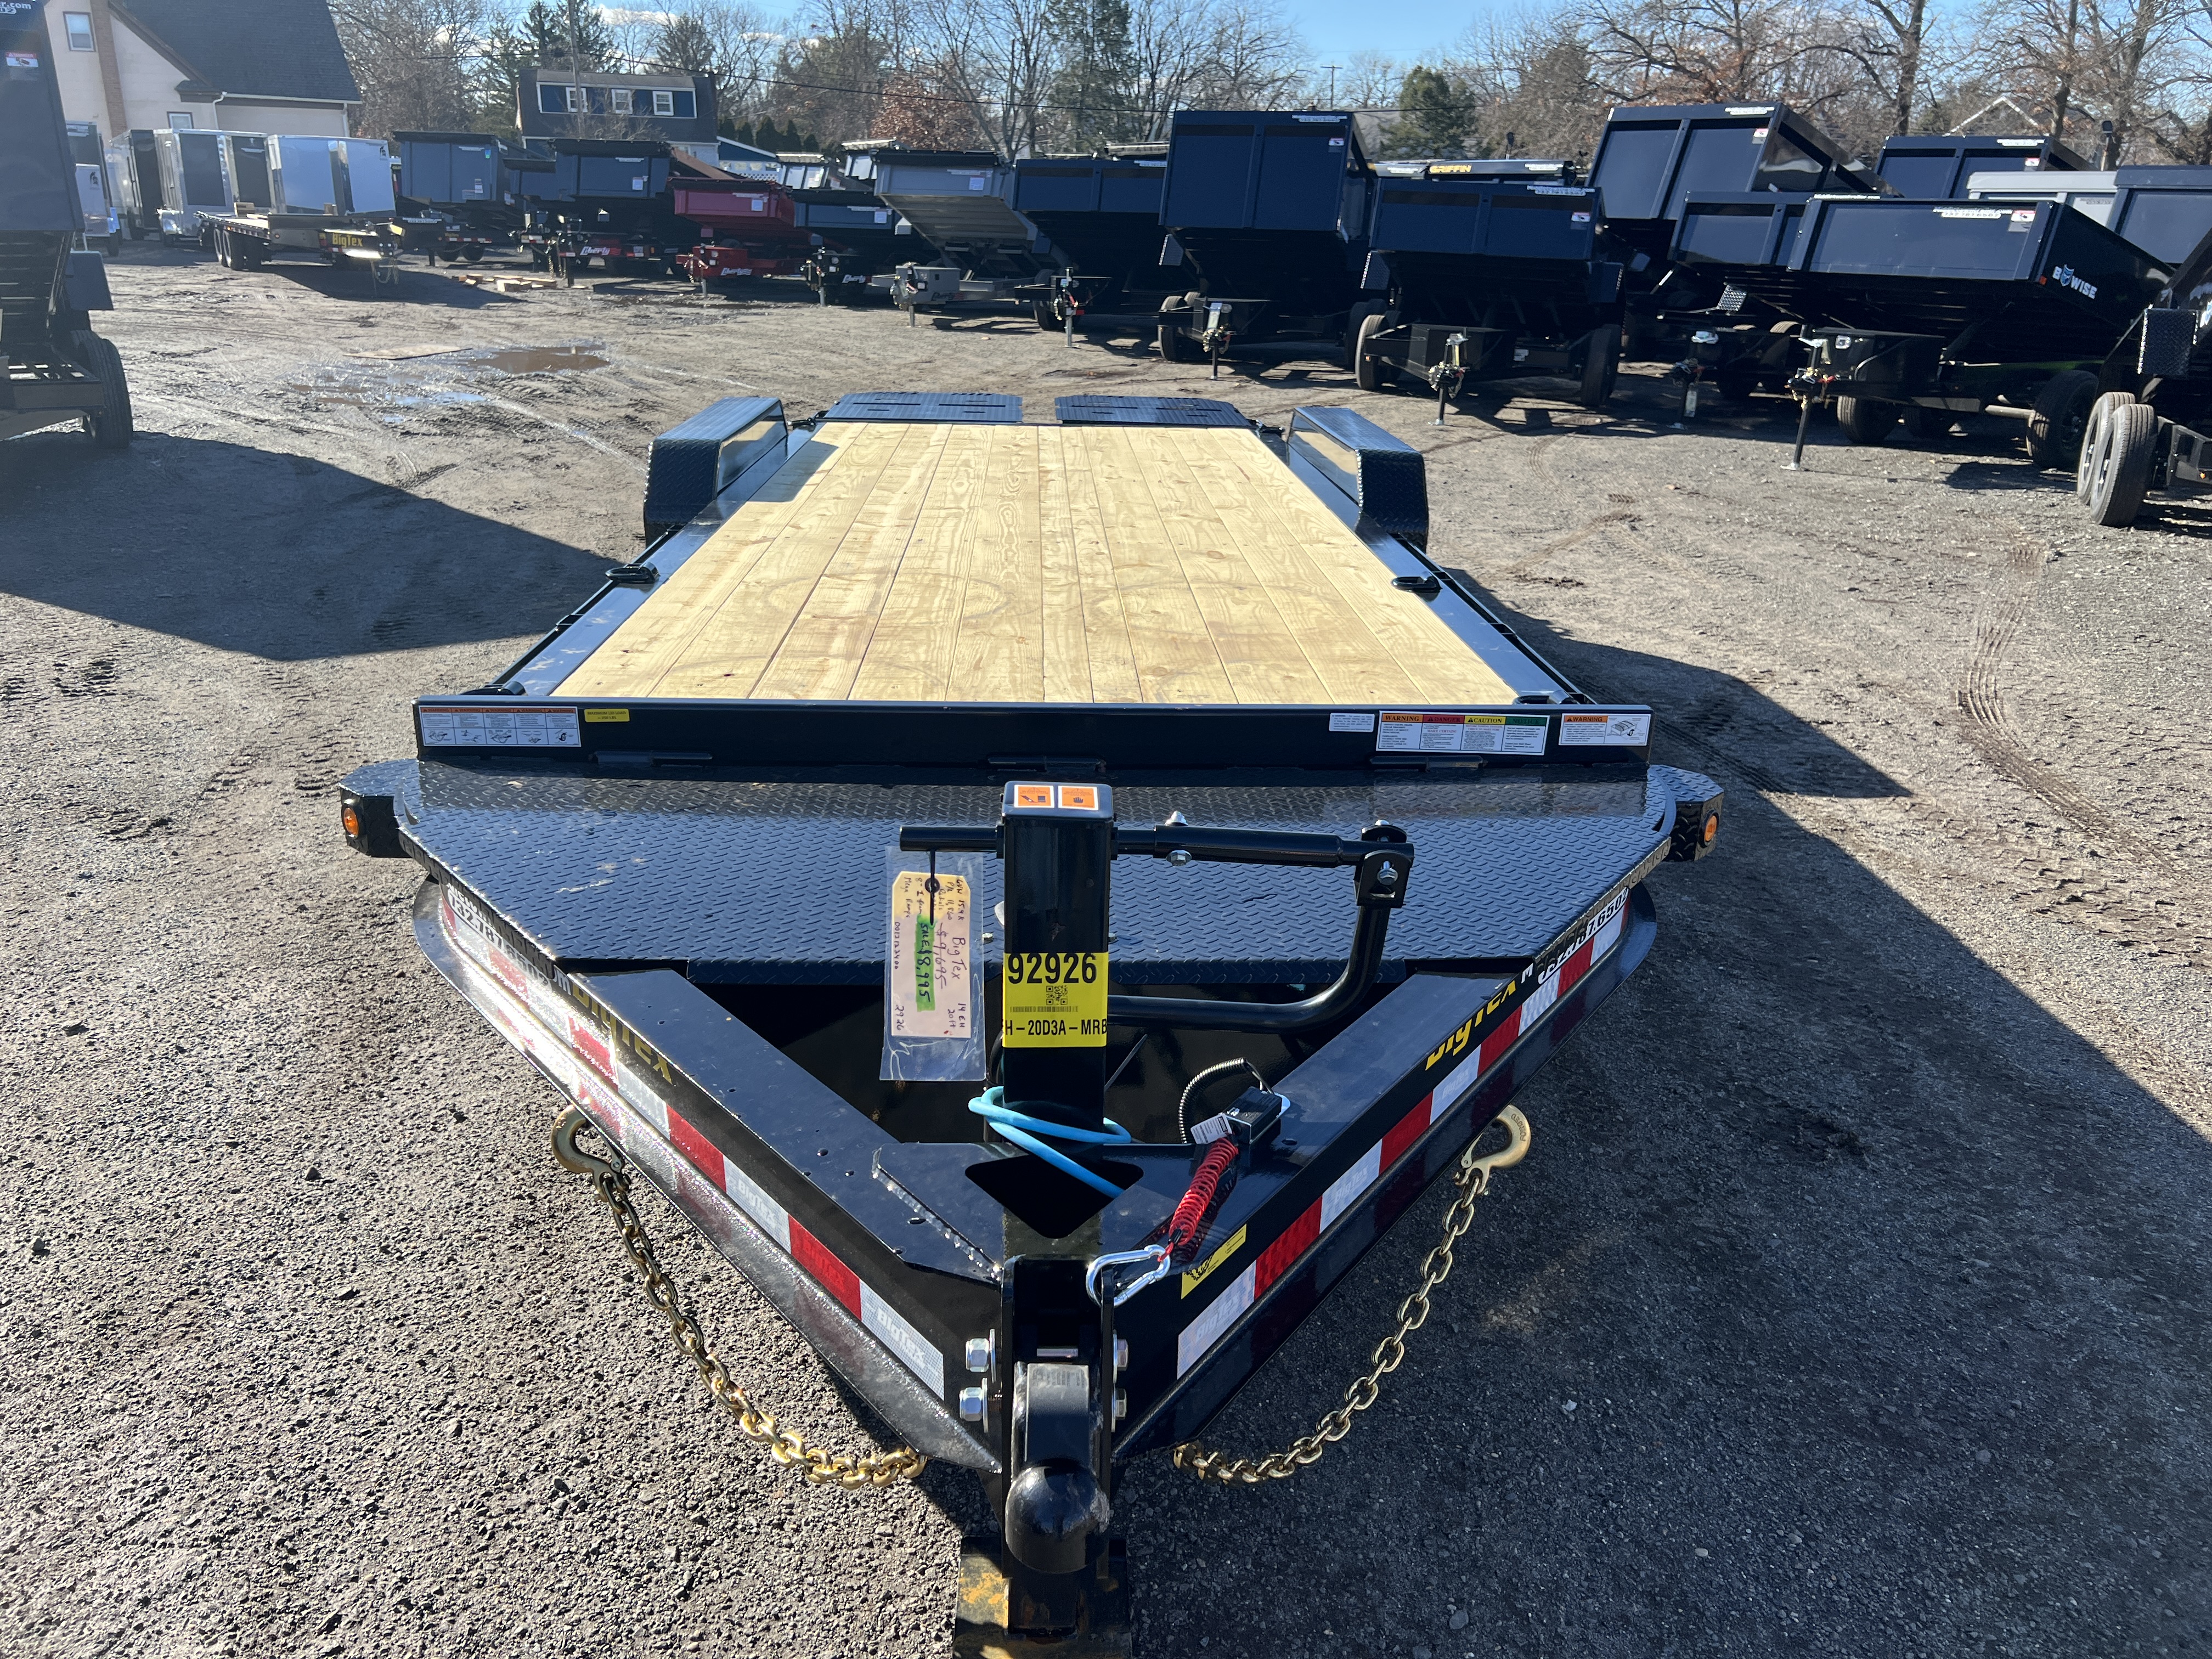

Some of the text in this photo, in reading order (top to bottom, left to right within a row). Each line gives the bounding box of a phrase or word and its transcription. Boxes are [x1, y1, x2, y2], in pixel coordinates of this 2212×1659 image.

[1429, 164, 1472, 173] GRIFFIN
[332, 233, 363, 247] BigTex
[921, 923, 930, 949] SALE
[947, 938, 966, 978] Big Tex
[1008, 952, 1096, 984] 92926
[894, 1005, 904, 1030] 2926
[958, 1003, 966, 1011] 14
[1511, 1113, 1526, 1142] FORGED
[877, 1307, 926, 1362] BigTex
